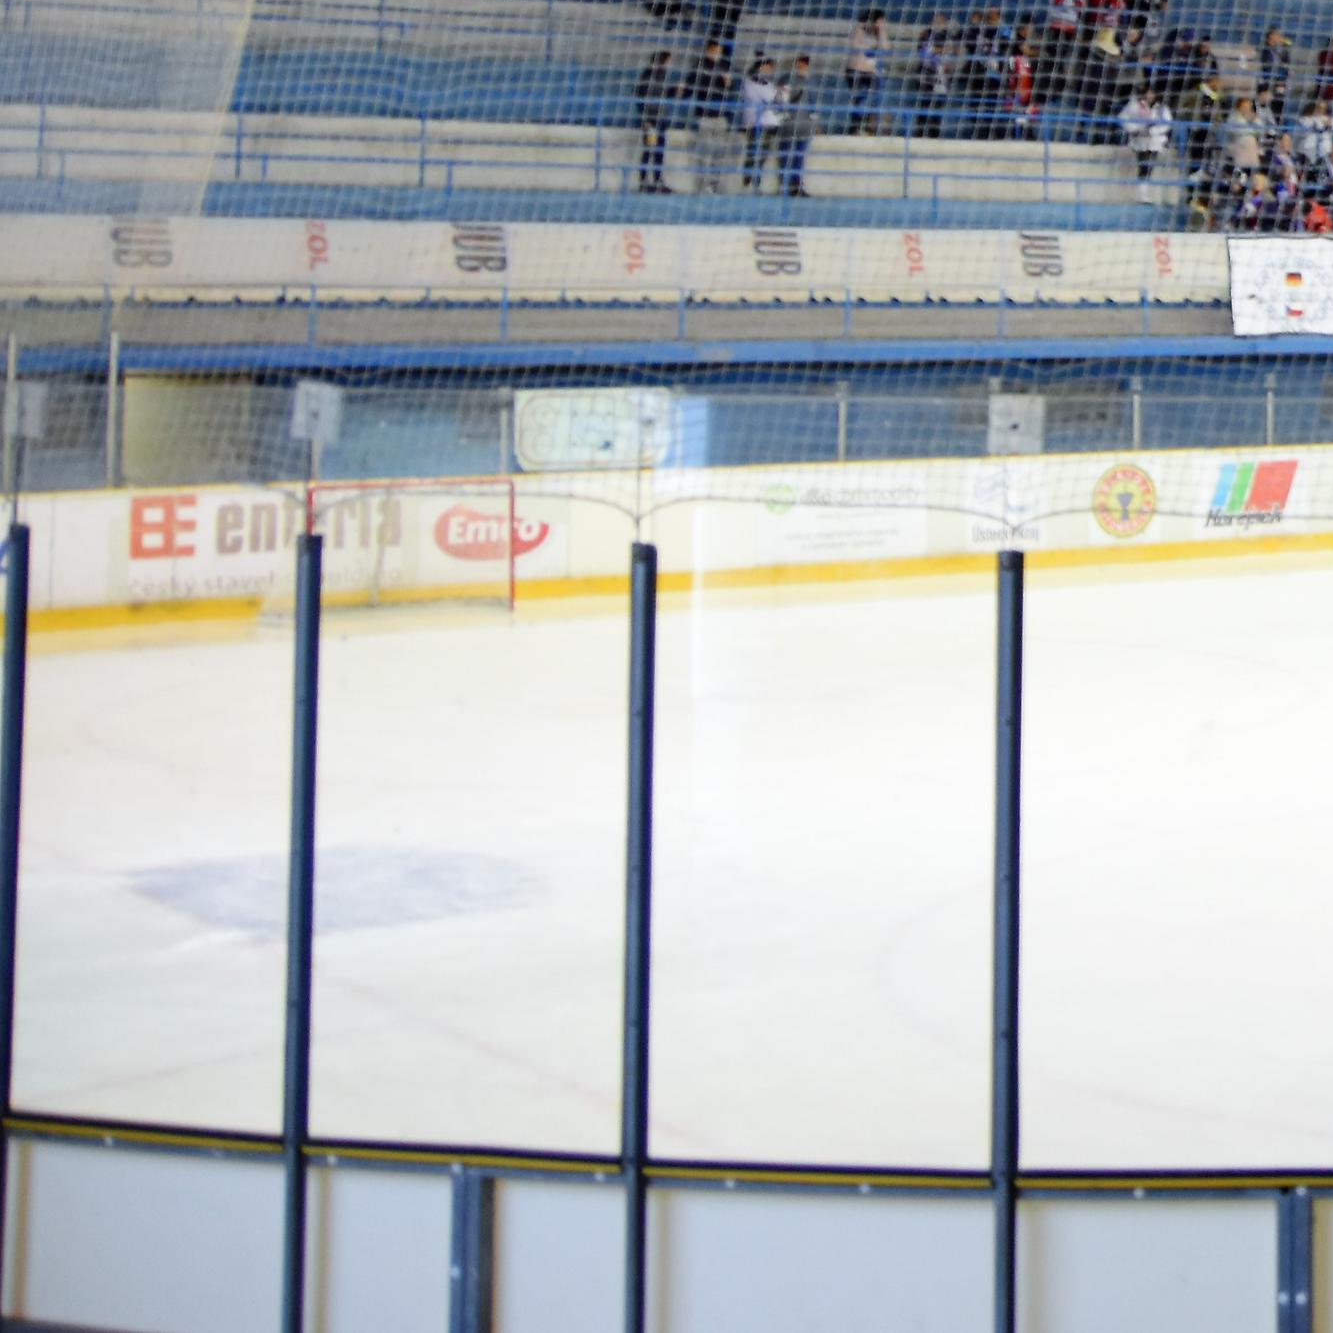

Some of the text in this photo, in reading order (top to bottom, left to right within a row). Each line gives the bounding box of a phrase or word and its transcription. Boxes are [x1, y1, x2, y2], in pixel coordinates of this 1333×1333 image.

[750, 228, 803, 277] JUB
[1018, 231, 1064, 279] JUB
[216, 495, 403, 555] entria
